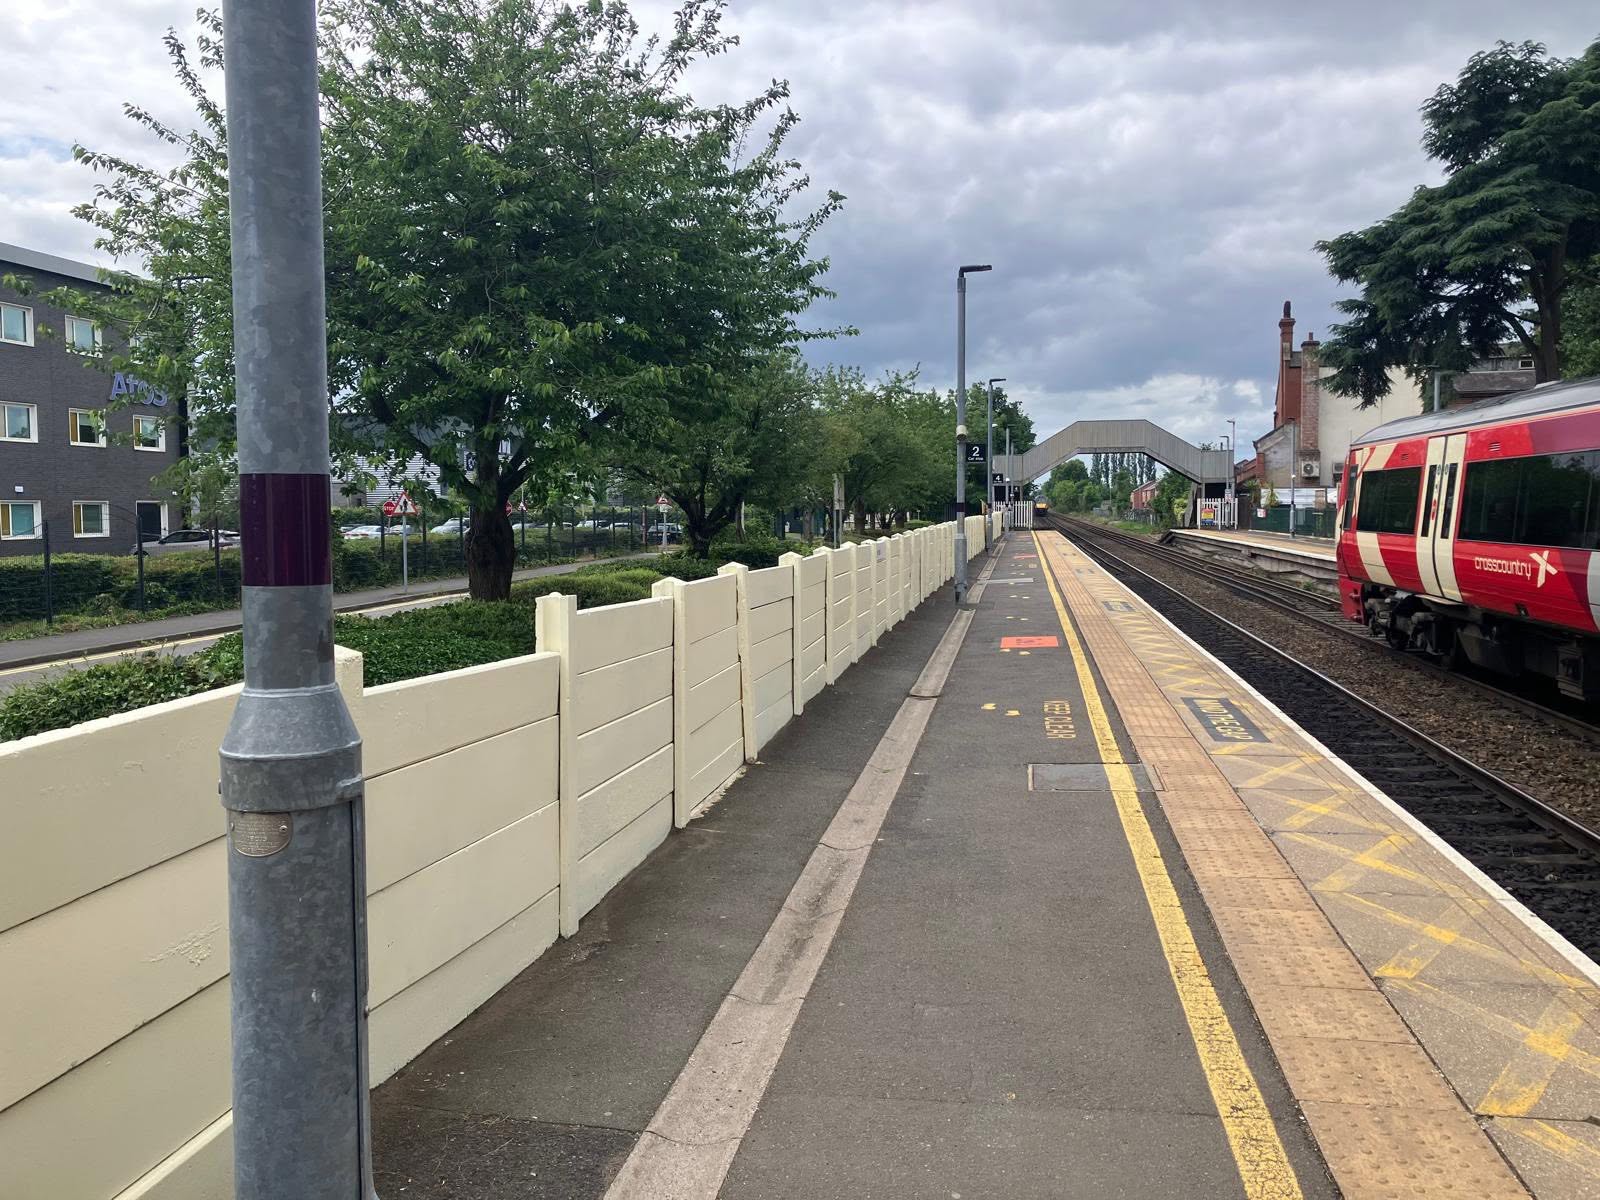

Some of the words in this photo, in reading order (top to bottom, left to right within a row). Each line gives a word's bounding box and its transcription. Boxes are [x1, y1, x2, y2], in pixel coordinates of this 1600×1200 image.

[111, 372, 168, 407] Atos
[972, 446, 980, 457] 2
[1475, 557, 1531, 580] crosscountry
[1043, 700, 1071, 714] KEEP
[1192, 699, 1228, 714] MIND
[1206, 714, 1241, 726] THE
[1044, 716, 1077, 739] CLEAR
[1215, 726, 1254, 740] GAP
